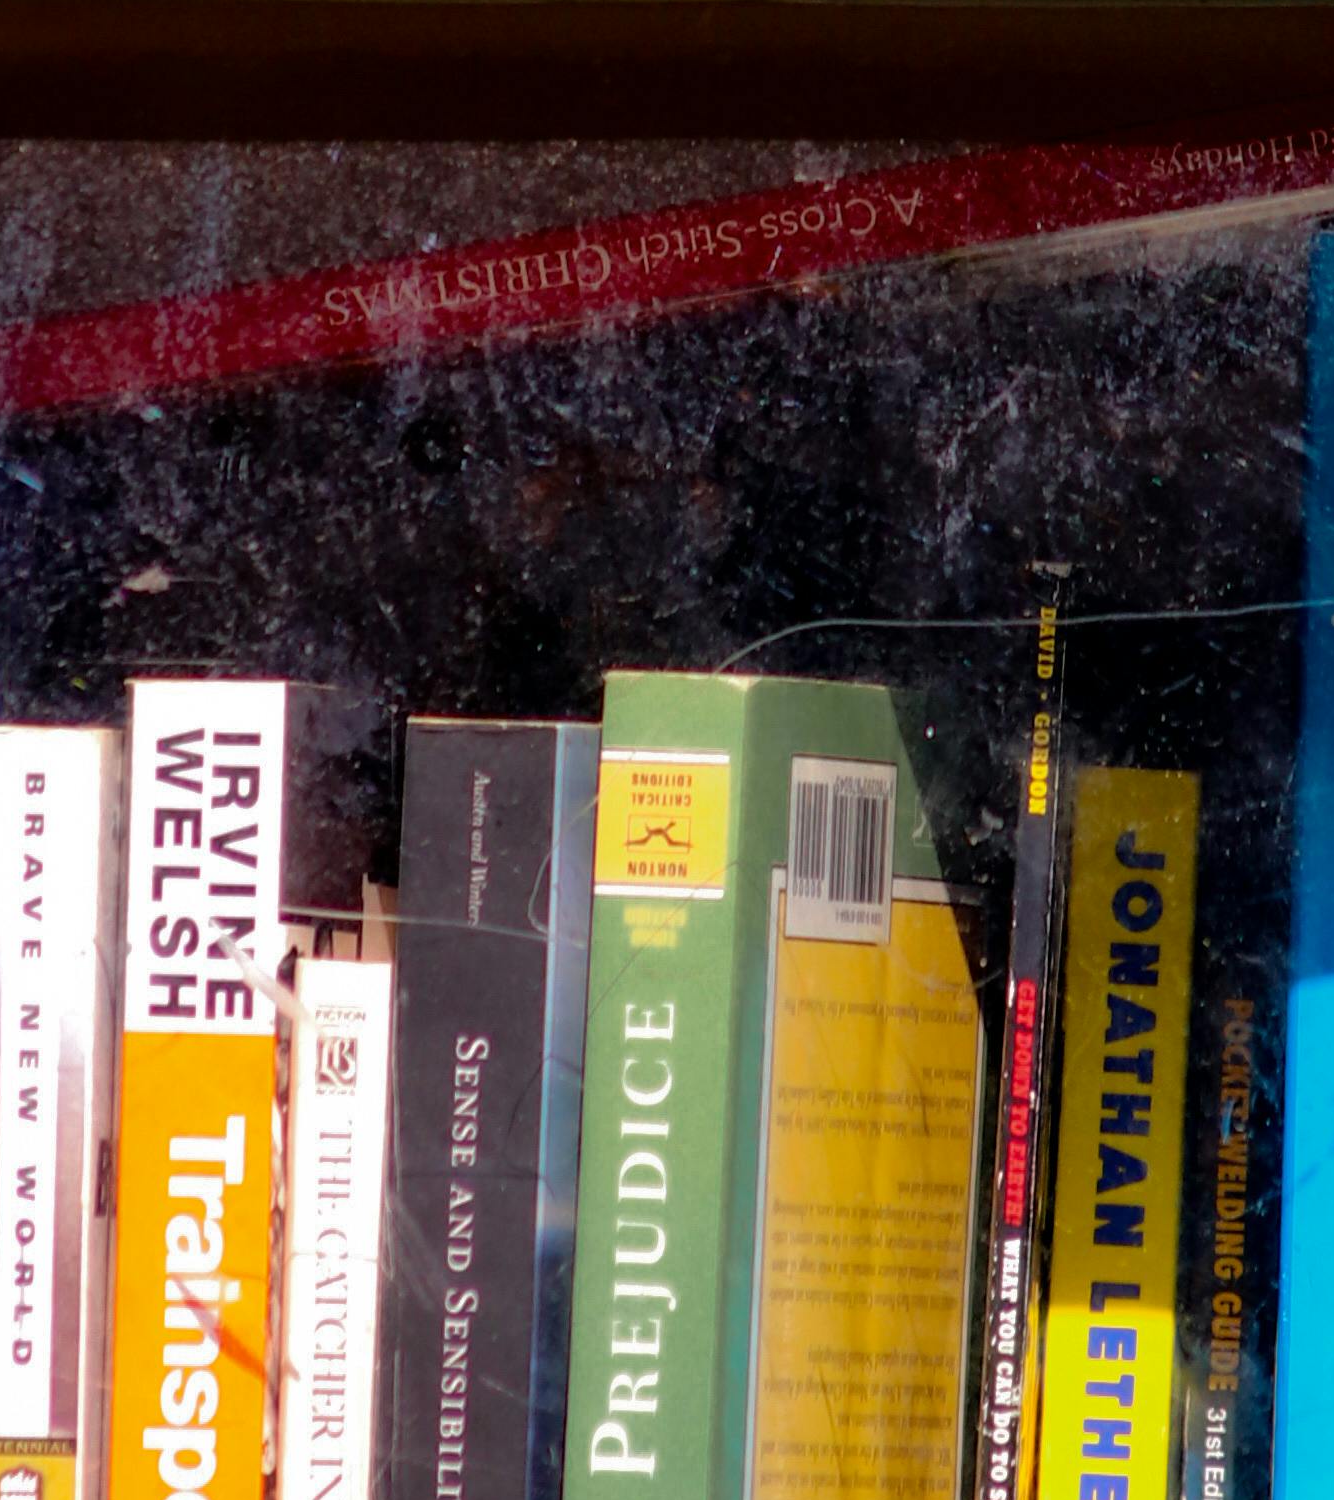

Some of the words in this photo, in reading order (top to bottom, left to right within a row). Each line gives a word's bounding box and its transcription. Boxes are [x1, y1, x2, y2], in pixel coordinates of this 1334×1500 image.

[1150, 130, 1299, 180] Holidays
[623, 194, 878, 264] Cross-Stitch
[897, 187, 924, 227] A
[323, 240, 614, 328] CHRISTMAS
[1036, 605, 1058, 680] DAVID
[630, 771, 693, 788] EDITIONS
[630, 791, 693, 808] CRITICAL
[1027, 710, 1052, 817] GORDON
[20, 771, 46, 960] BRAVE
[147, 727, 206, 1020] WELSH
[204, 731, 262, 1021] IRVINE
[626, 860, 688, 879] NORTON
[1015, 979, 1037, 1029] GET
[1092, 830, 1165, 1248] JONATHAN
[17, 1003, 41, 1124] NEW
[450, 1034, 490, 1168] SENSE
[1011, 1032, 1035, 1099] DOWN
[1217, 997, 1255, 1134] POCKET
[1008, 1102, 1031, 1138] TO
[316, 1118, 354, 1216] THE
[1002, 1140, 1028, 1229] EARTH!
[1213, 1136, 1251, 1282] WELDING
[10, 1165, 37, 1366] WORLD
[445, 1182, 475, 1274] AND
[588, 1001, 676, 1480] PREJUDICE
[999, 1238, 1023, 1303] WHAT
[310, 1226, 350, 1442] CATCHER
[996, 1308, 1018, 1357] YOU
[1208, 1292, 1244, 1393] GUIDE
[992, 1360, 1016, 1406] CAN
[988, 1450, 1010, 1484] TO
[990, 1410, 1013, 1446] DO
[1203, 1406, 1227, 1462] 31st
